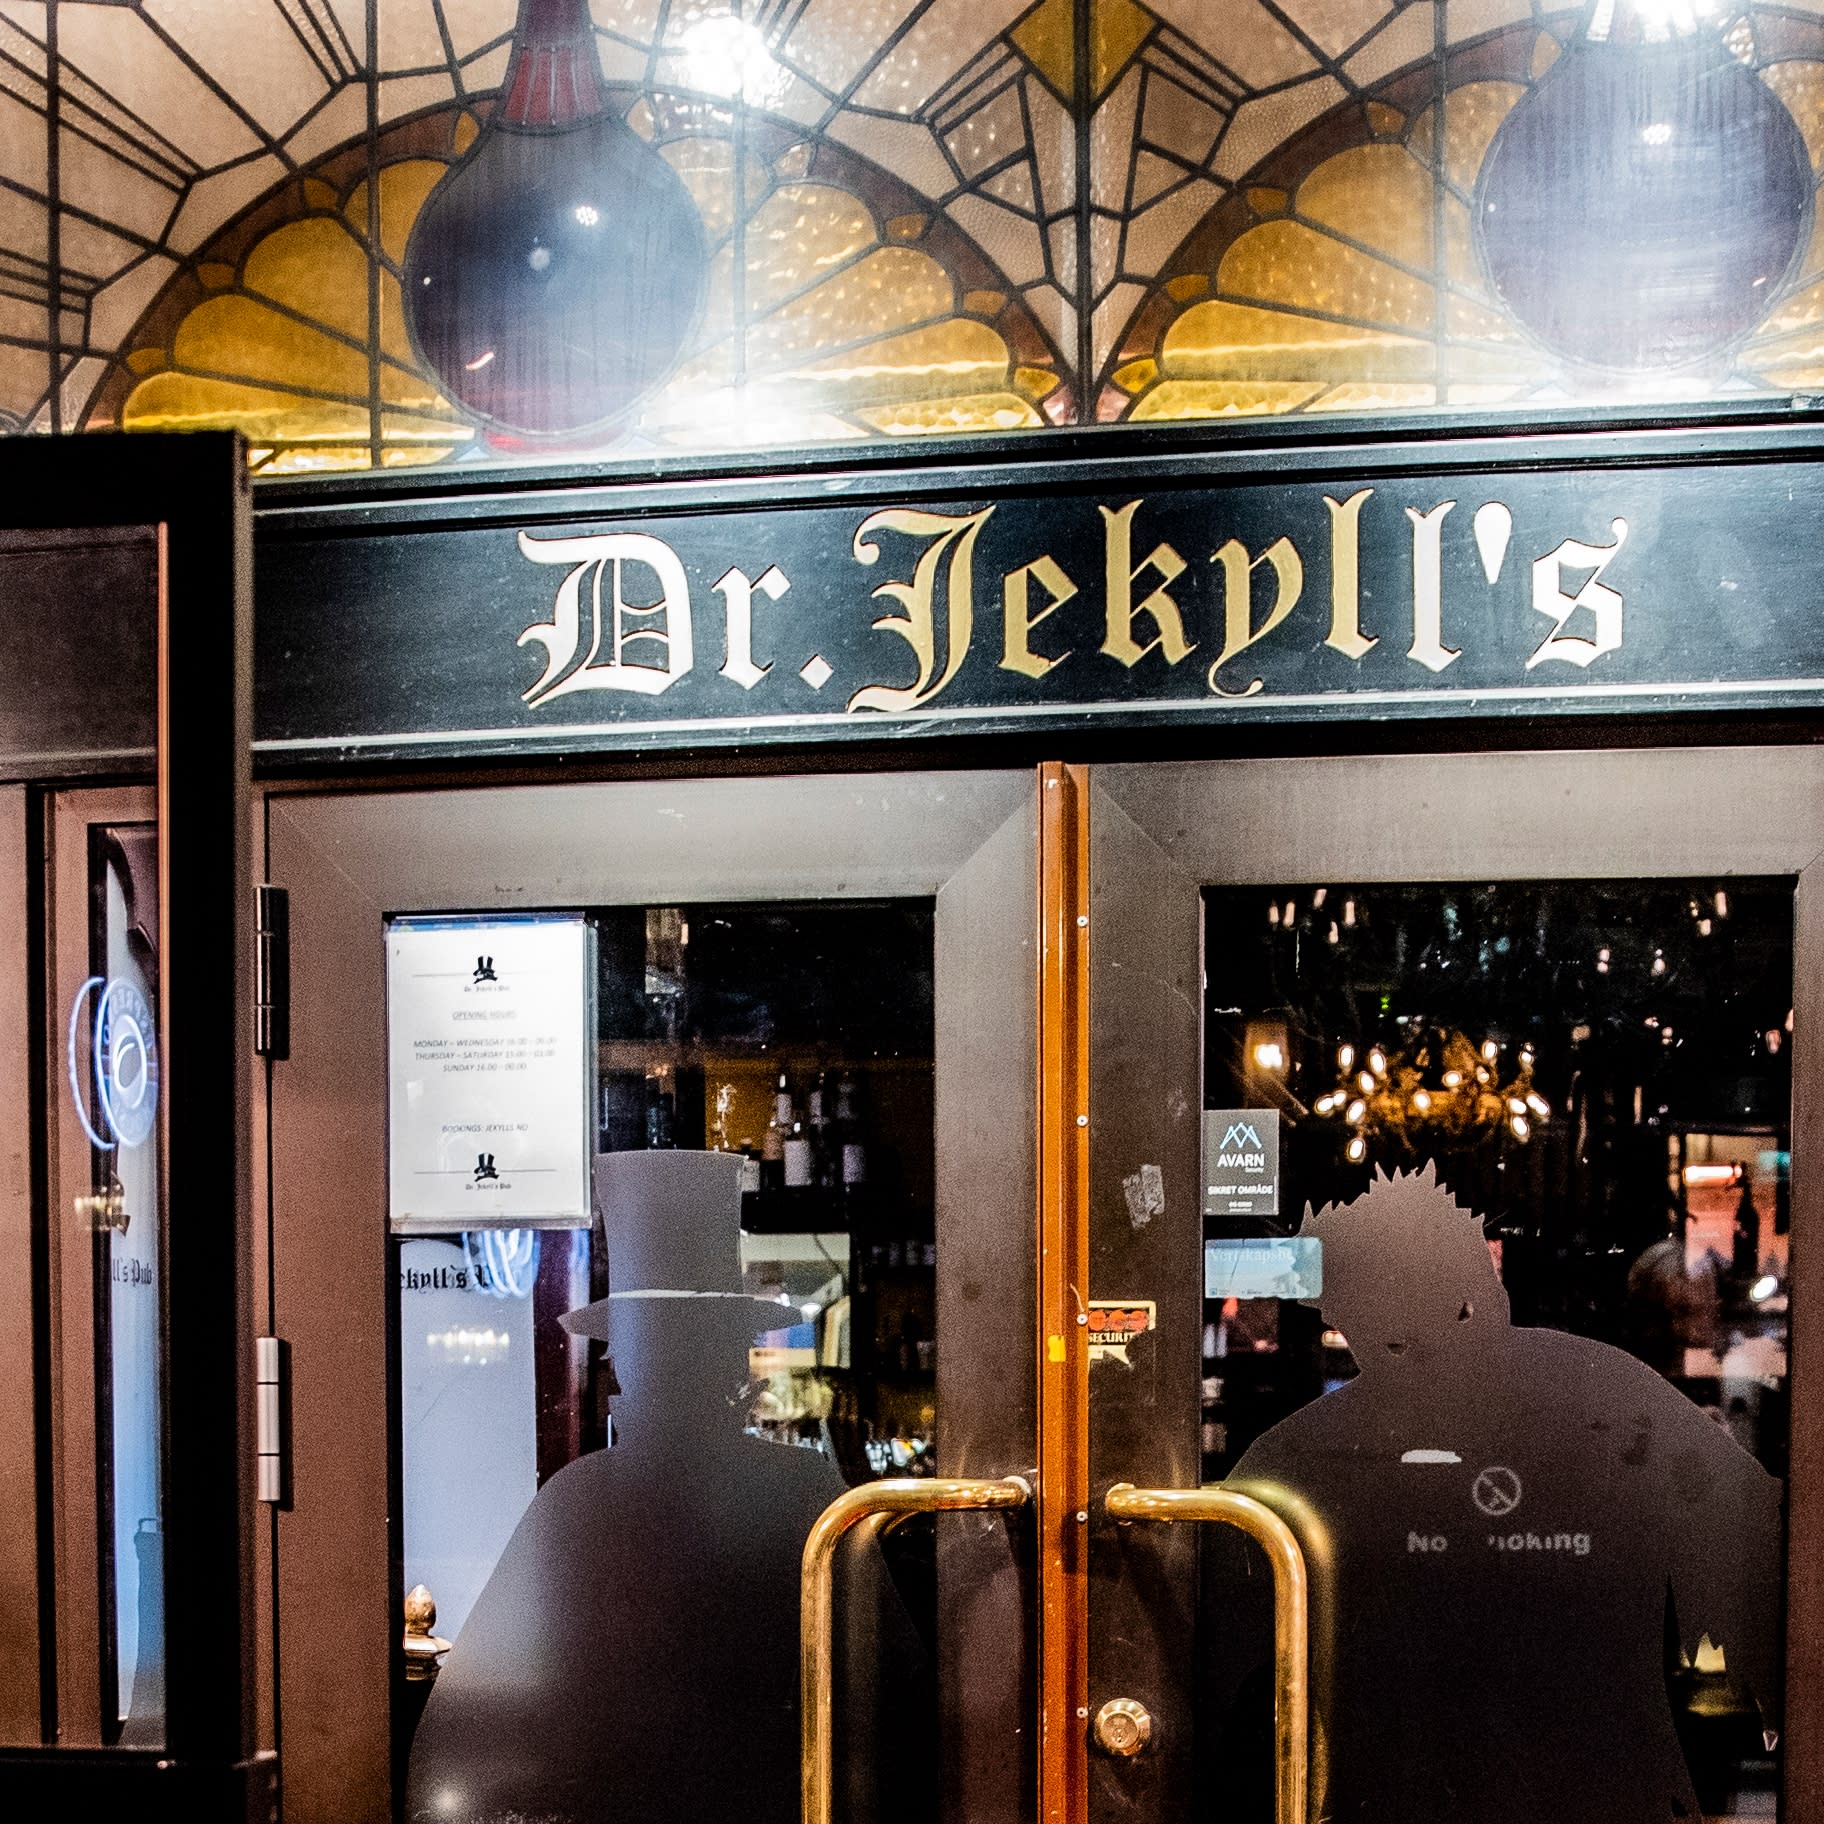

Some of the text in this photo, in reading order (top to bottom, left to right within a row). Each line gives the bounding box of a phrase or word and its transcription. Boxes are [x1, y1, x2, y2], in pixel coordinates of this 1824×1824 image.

[516, 486, 1631, 717] Dr. Jekyll's
[413, 1039, 448, 1049] MONDAY
[415, 1051, 455, 1061] THURSDAY
[442, 1064, 475, 1074] SUNDAY
[1217, 1153, 1265, 1168] AVARN
[131, 1258, 153, 1287] Pub
[1406, 1531, 1449, 1553] No
